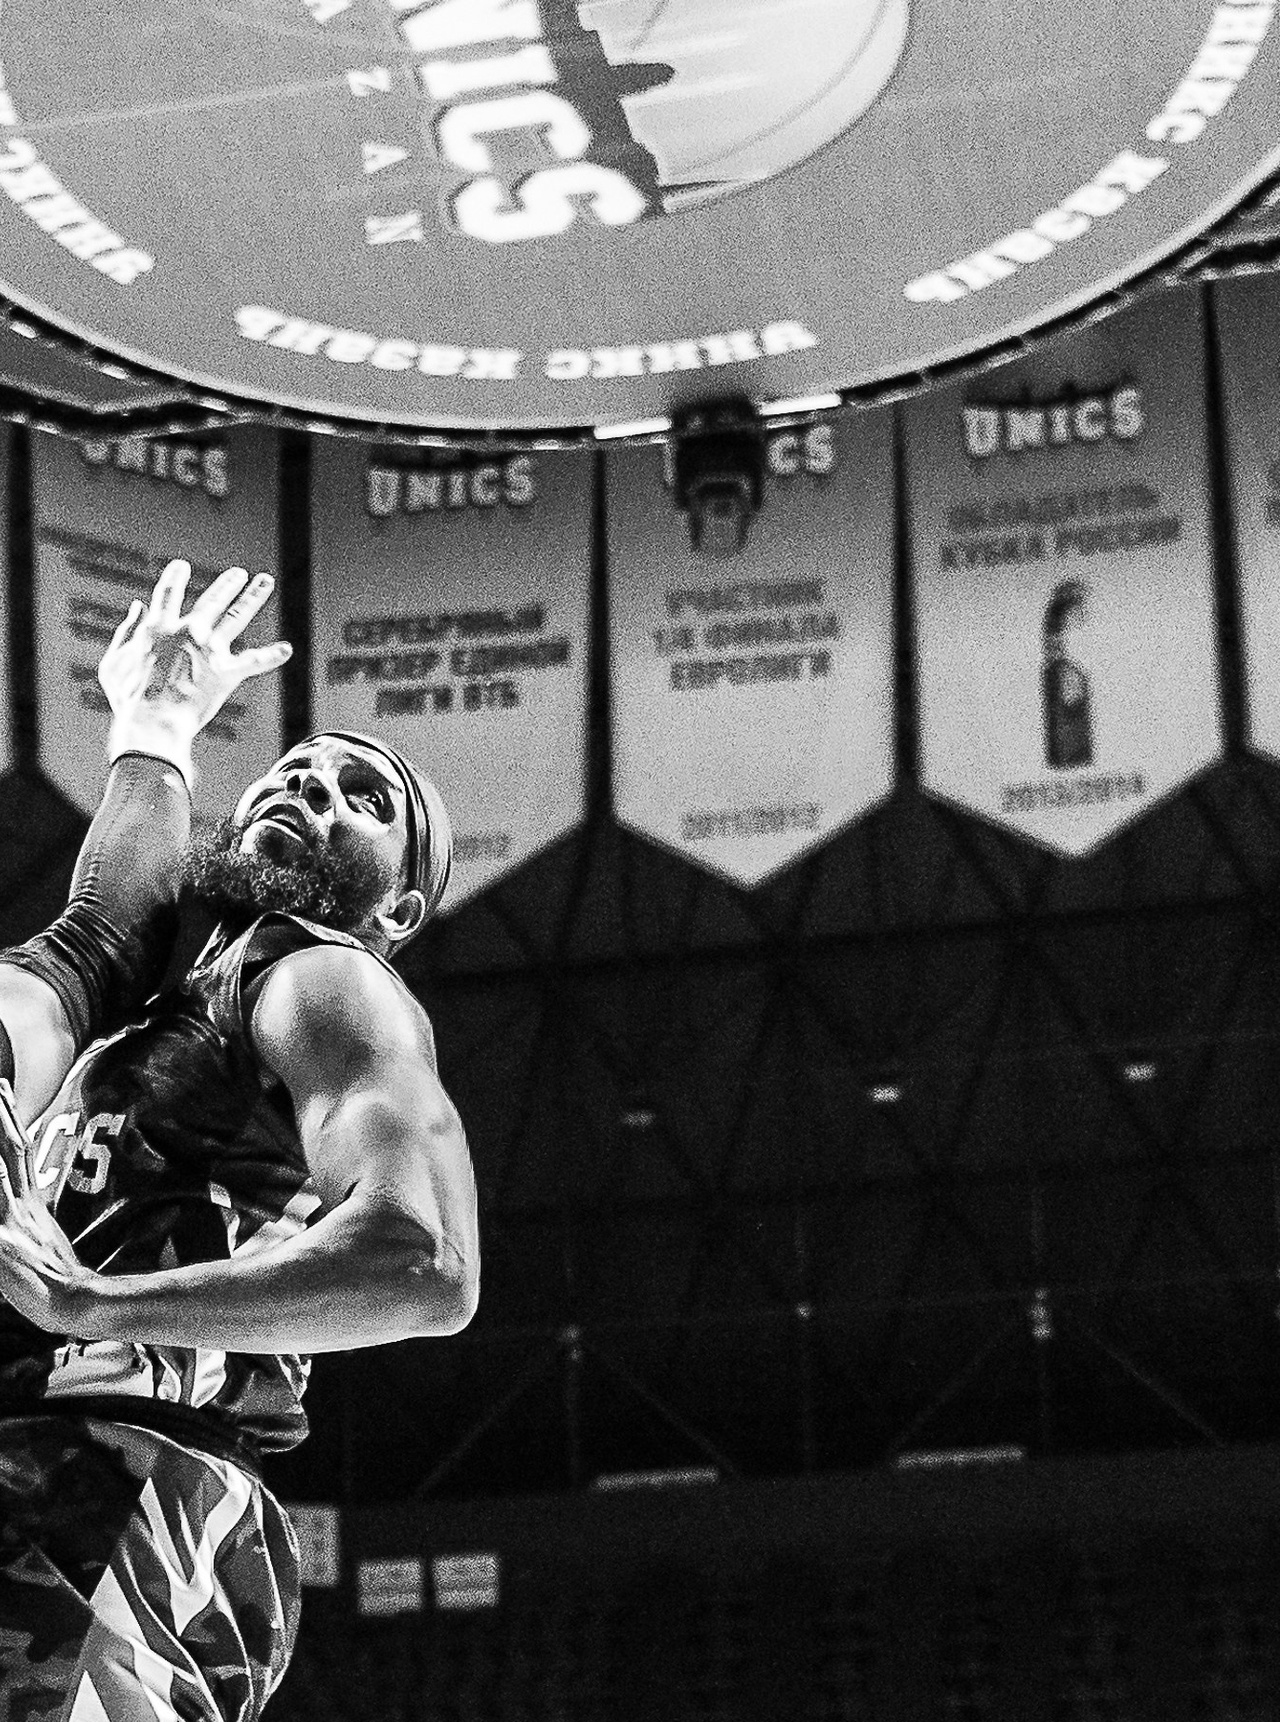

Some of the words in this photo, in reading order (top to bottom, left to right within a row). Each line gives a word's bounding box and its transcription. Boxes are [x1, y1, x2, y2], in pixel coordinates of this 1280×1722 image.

[390, 0, 646, 243] NICS
[964, 389, 1143, 455] UNICS
[368, 458, 535, 515] UNICS
